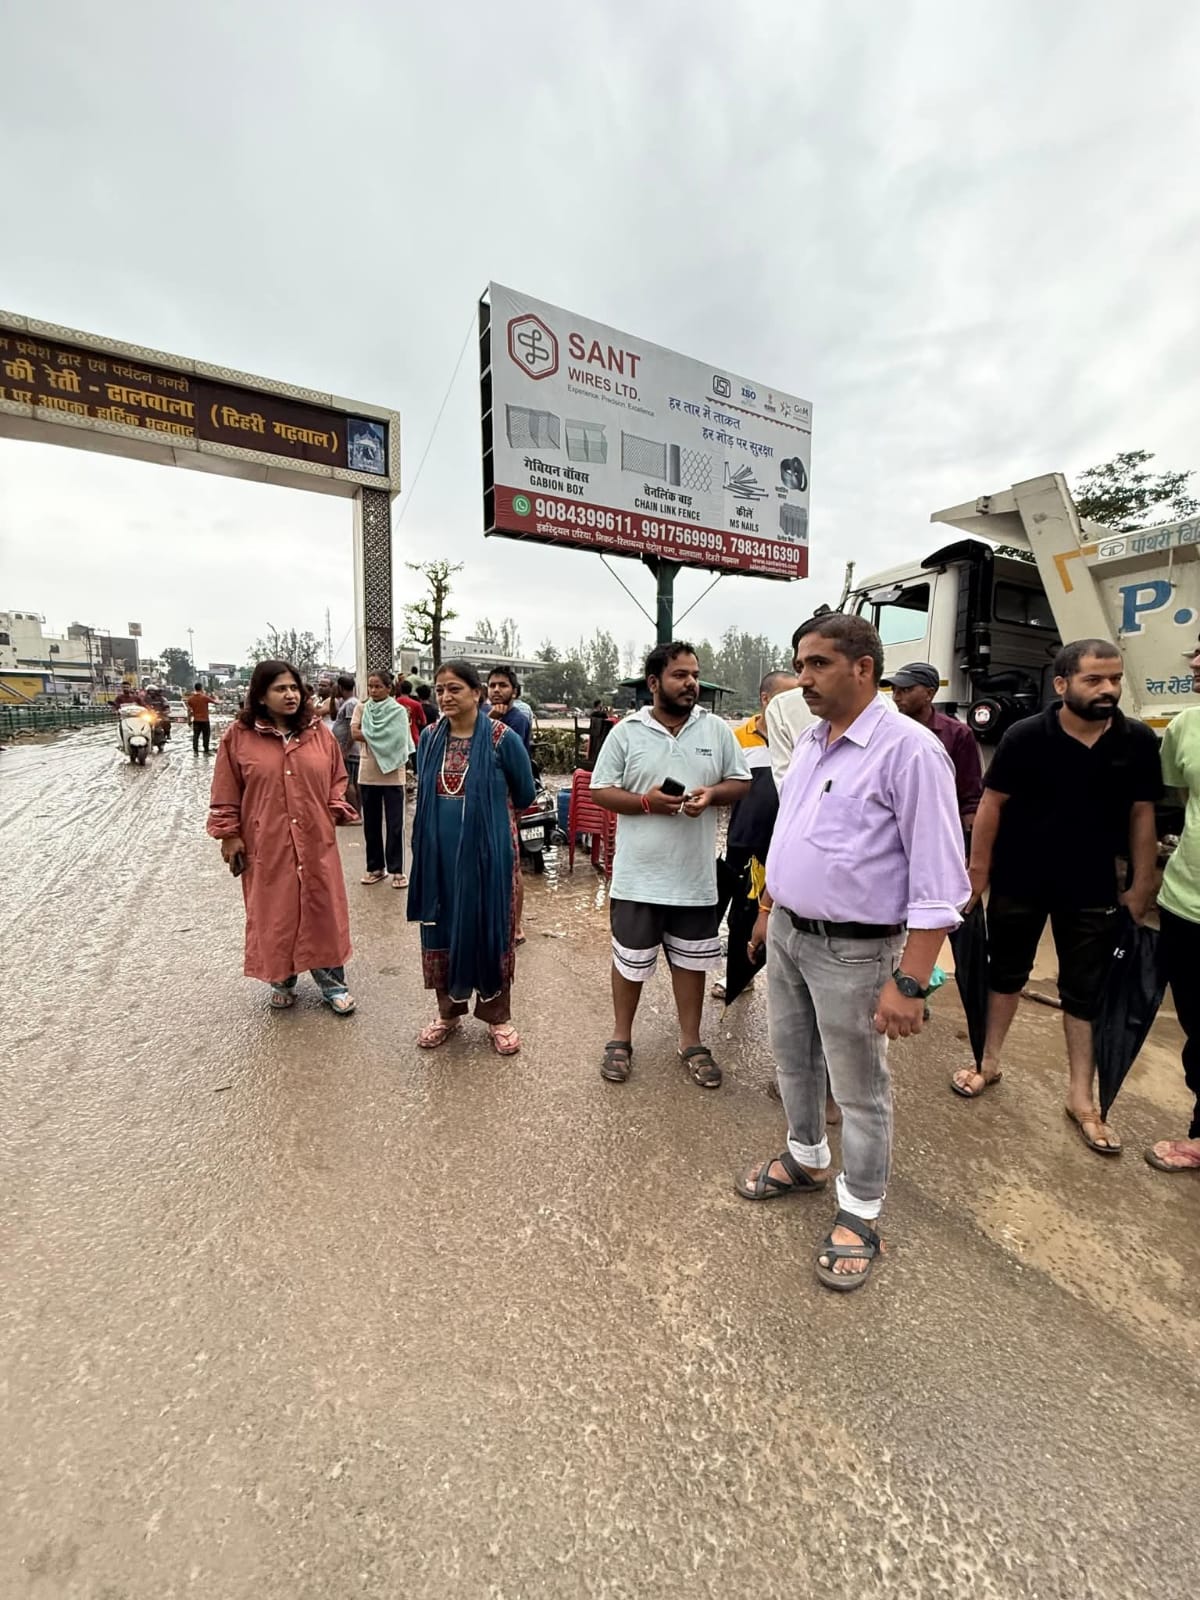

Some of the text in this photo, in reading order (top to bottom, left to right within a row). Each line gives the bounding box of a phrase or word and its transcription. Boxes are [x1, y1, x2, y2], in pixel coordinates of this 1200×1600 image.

[568, 332, 641, 379] SANT
[2, 357, 37, 384] की
[41, 363, 82, 394] रेती
[104, 383, 195, 419] ढालवाला
[112, 363, 153, 384] पर्यटन
[156, 376, 190, 393] नगरी
[567, 366, 641, 402] WIRES LTD.
[11, 388, 33, 404] पर
[38, 394, 90, 416] आपका
[668, 396, 681, 411] हर
[683, 400, 701, 418] तार
[702, 405, 712, 420] में
[741, 387, 757, 401] ISO
[210, 403, 267, 435] (टिहरी
[701, 426, 715, 441] हर
[736, 438, 748, 451] पर
[749, 440, 774, 458] सुरक्षा
[529, 474, 585, 497] GABION BOX
[634, 497, 701, 522] CHAIN LINK FENCE
[535, 498, 800, 564] 9084399611, 9917569999, 7983416390
[730, 518, 760, 533] MS NAILS
